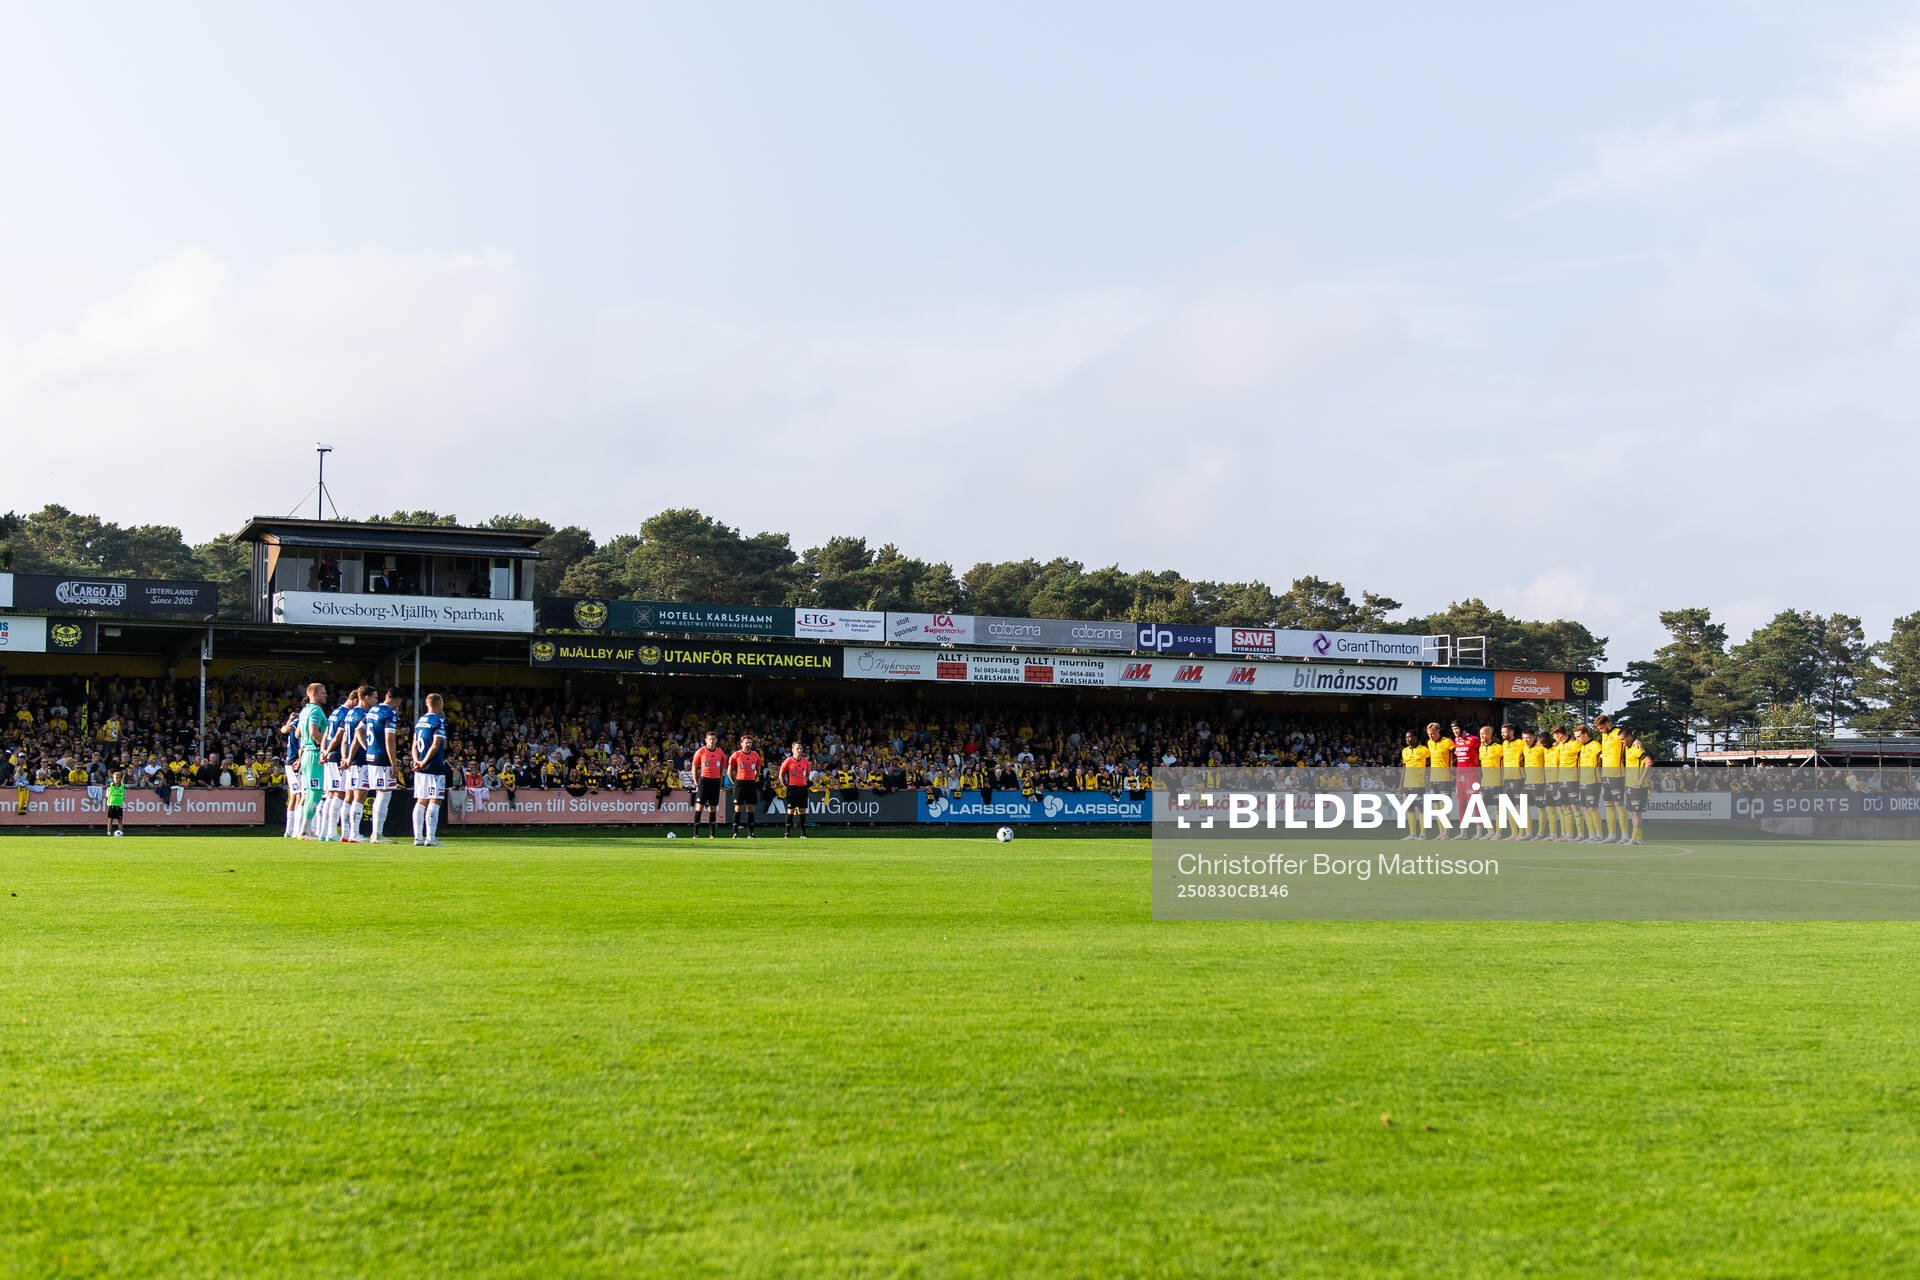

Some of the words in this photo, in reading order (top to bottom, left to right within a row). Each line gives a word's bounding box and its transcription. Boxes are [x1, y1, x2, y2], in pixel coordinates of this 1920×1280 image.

[72, 584, 107, 597] CARGO
[109, 585, 125, 598] AB
[145, 588, 199, 596] LISTERLANDET
[150, 595, 172, 604] Since
[173, 597, 194, 605] 2005
[312, 601, 440, 622] Sölvesborg-Mjällby
[443, 606, 505, 623] Sparbank
[659, 611, 701, 620] HOTELL
[706, 613, 773, 623] KARLSHAMN
[804, 614, 828, 625] ETG
[933, 614, 954, 627] ICA
[0, 622, 8, 631] S
[894, 625, 918, 637] sponsor
[924, 626, 966, 634] Supermarket
[936, 635, 951, 643] Osby
[1139, 623, 1173, 652] dp
[1177, 636, 1213, 644] SPORTS
[559, 646, 614, 659] MJÄLLBY
[616, 649, 635, 660] AIF
[1337, 639, 1368, 652] Grant
[1369, 640, 1419, 655] Thornton
[664, 650, 733, 665] UTANFÖR
[737, 653, 832, 668] REKTANGELN
[937, 653, 963, 662] ALLT
[973, 656, 1020, 665] murning
[1024, 657, 1050, 665] ALLT
[1059, 658, 1104, 669] murning
[974, 674, 1020, 682] KARLSHAMN
[1293, 667, 1398, 691] bilmånsson
[1430, 675, 1486, 685] Handelsbanken
[1511, 685, 1551, 694] Elbolaget
[366, 723, 374, 746] 5
[417, 730, 425, 753] 6
[53, 798, 75, 812] till
[80, 798, 182, 815] Slsborgs
[186, 799, 257, 812] kommun
[466, 799, 542, 812] äommen
[546, 799, 565, 812] till
[569, 799, 656, 814] Sölvesborgs
[659, 799, 719, 812] kom
[950, 804, 1031, 815] LARSSON
[1065, 804, 1142, 814] LARSSON
[1647, 799, 1712, 811] ianstadsbladet
[1773, 798, 1850, 812] SPORTS
